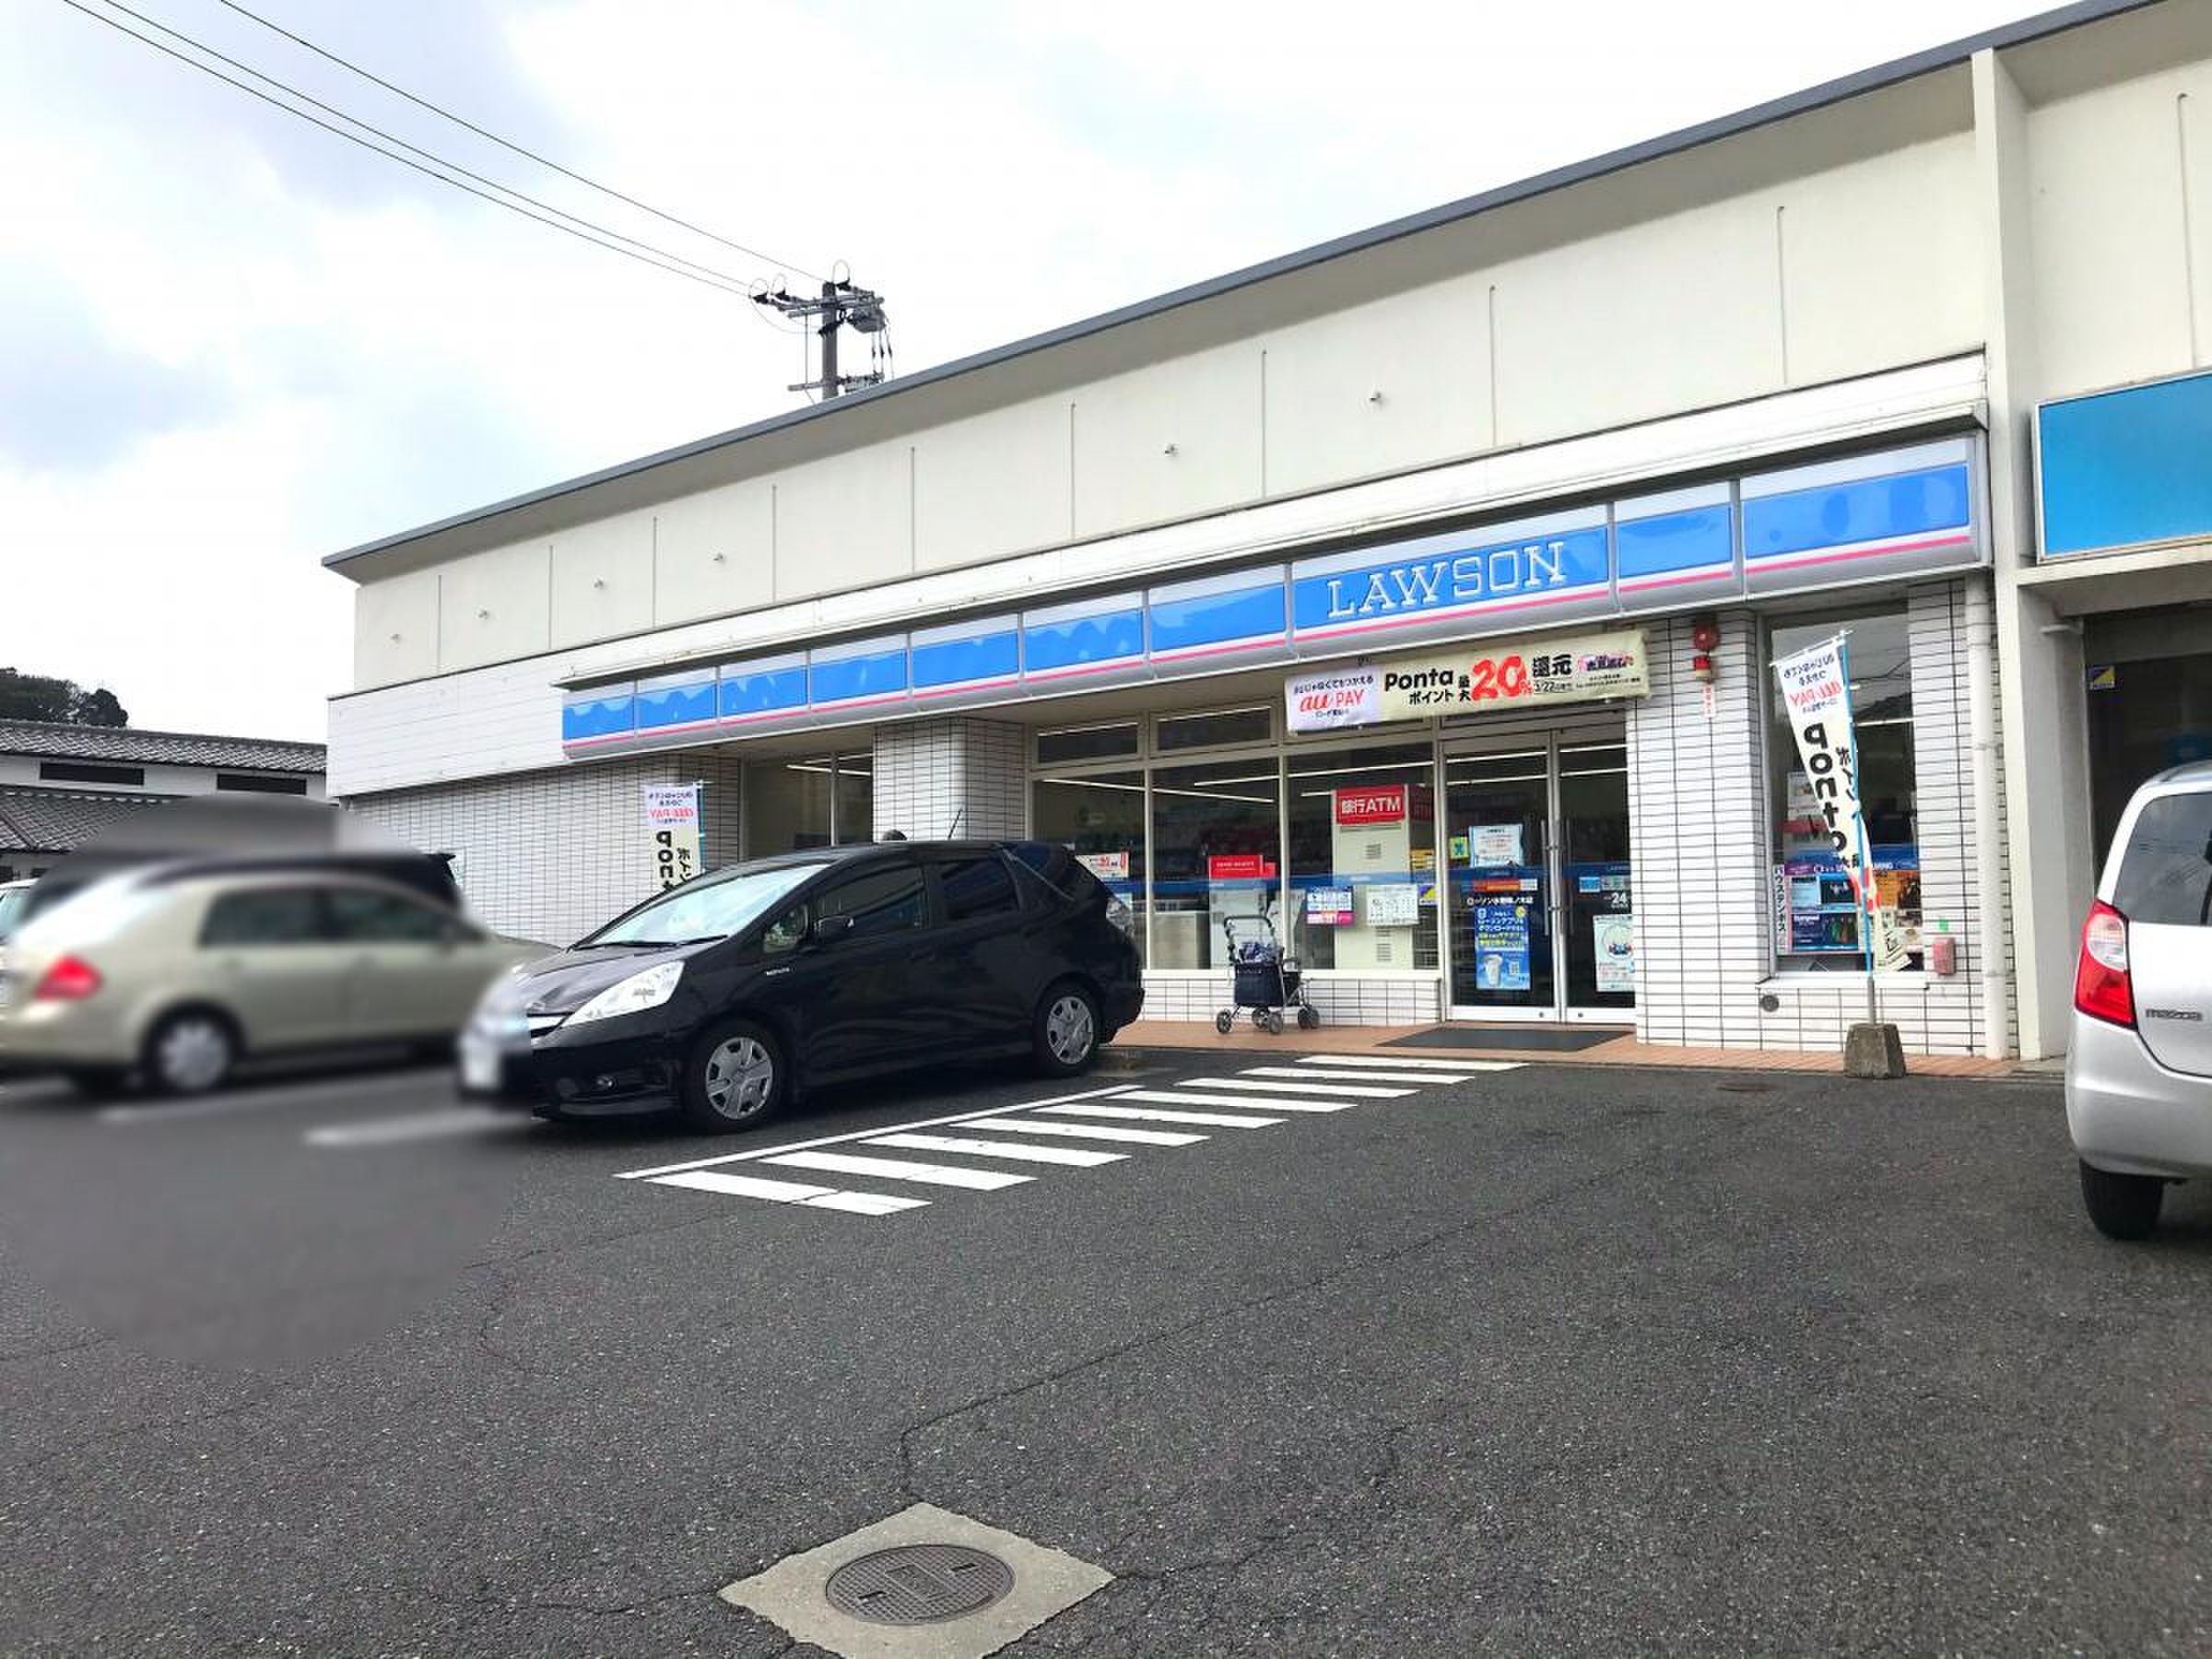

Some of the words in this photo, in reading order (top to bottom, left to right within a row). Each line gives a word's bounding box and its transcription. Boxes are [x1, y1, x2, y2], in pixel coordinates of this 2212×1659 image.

[1326, 541, 1566, 618] LAWSON
[1385, 668, 1454, 692] Ponta
[1336, 689, 1364, 708] PAY
[1409, 689, 1453, 705] ポイント
